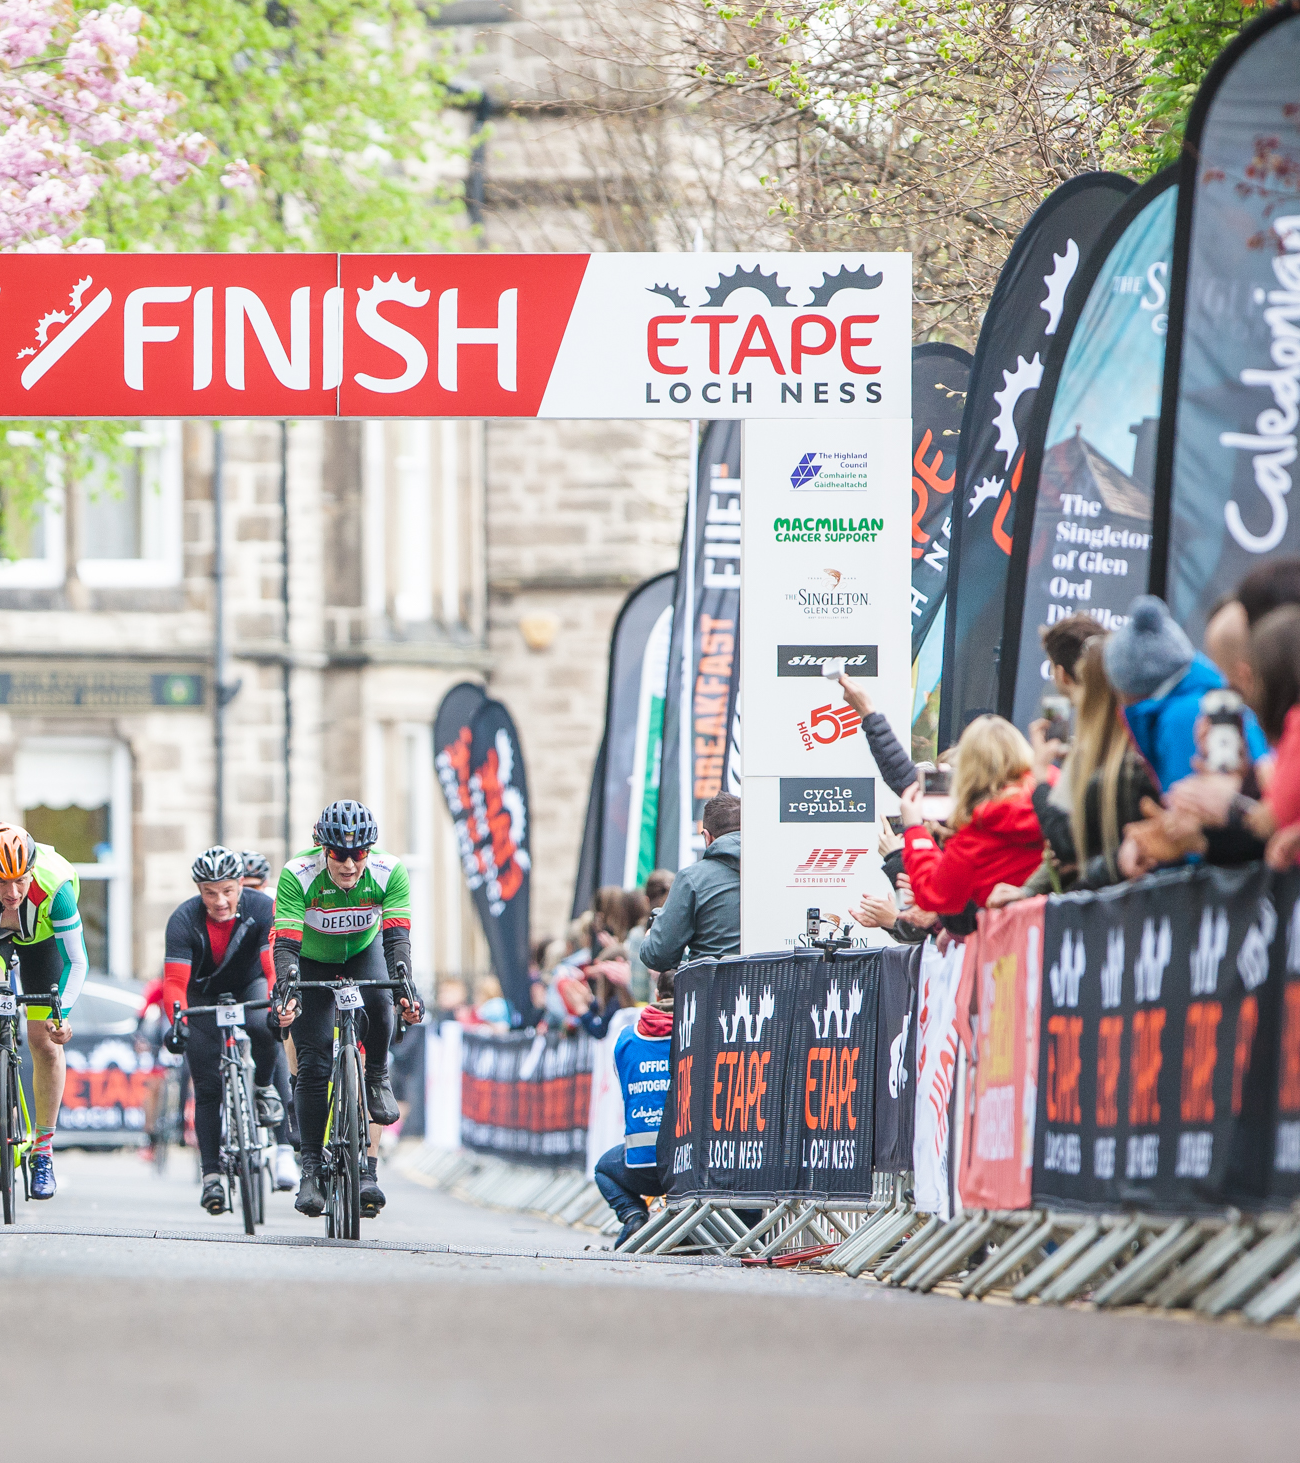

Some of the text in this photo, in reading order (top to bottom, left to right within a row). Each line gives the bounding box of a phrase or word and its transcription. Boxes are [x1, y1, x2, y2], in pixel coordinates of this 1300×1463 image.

[124, 271, 518, 393] FINISH
[647, 314, 882, 376] ETAPE
[646, 382, 883, 404] LOCH NESS
[819, 452, 868, 461] The Highland
[840, 461, 868, 469] Council
[819, 472, 857, 480] Comhairle
[1059, 493, 1102, 518] The
[774, 517, 884, 532] MACMILLAN
[775, 533, 878, 543] CANCER SUPPORT
[1052, 549, 1129, 577] of Glen
[785, 593, 797, 601] THE
[1049, 576, 1093, 601] Ord
[803, 606, 853, 615] GLEN ORD
[693, 614, 734, 799] BREAKFAST
[796, 721, 815, 752] HIGH
[803, 786, 853, 802] cycle
[788, 800, 867, 816] republic
[794, 848, 870, 873] JBT
[321, 912, 372, 929] DEESIDE
[339, 993, 358, 1005] 545
[224, 1011, 237, 1020] 64
[639, 1060, 669, 1074] OFFICI
[627, 1079, 671, 1096] PHOTOGR
[712, 1050, 771, 1133] ETAPE
[804, 1046, 860, 1132] ETAPE
[631, 1105, 663, 1119] Caledoni
[708, 1139, 735, 1169] LOCH
[738, 1140, 764, 1170] NESS
[802, 1138, 832, 1169] LOCH
